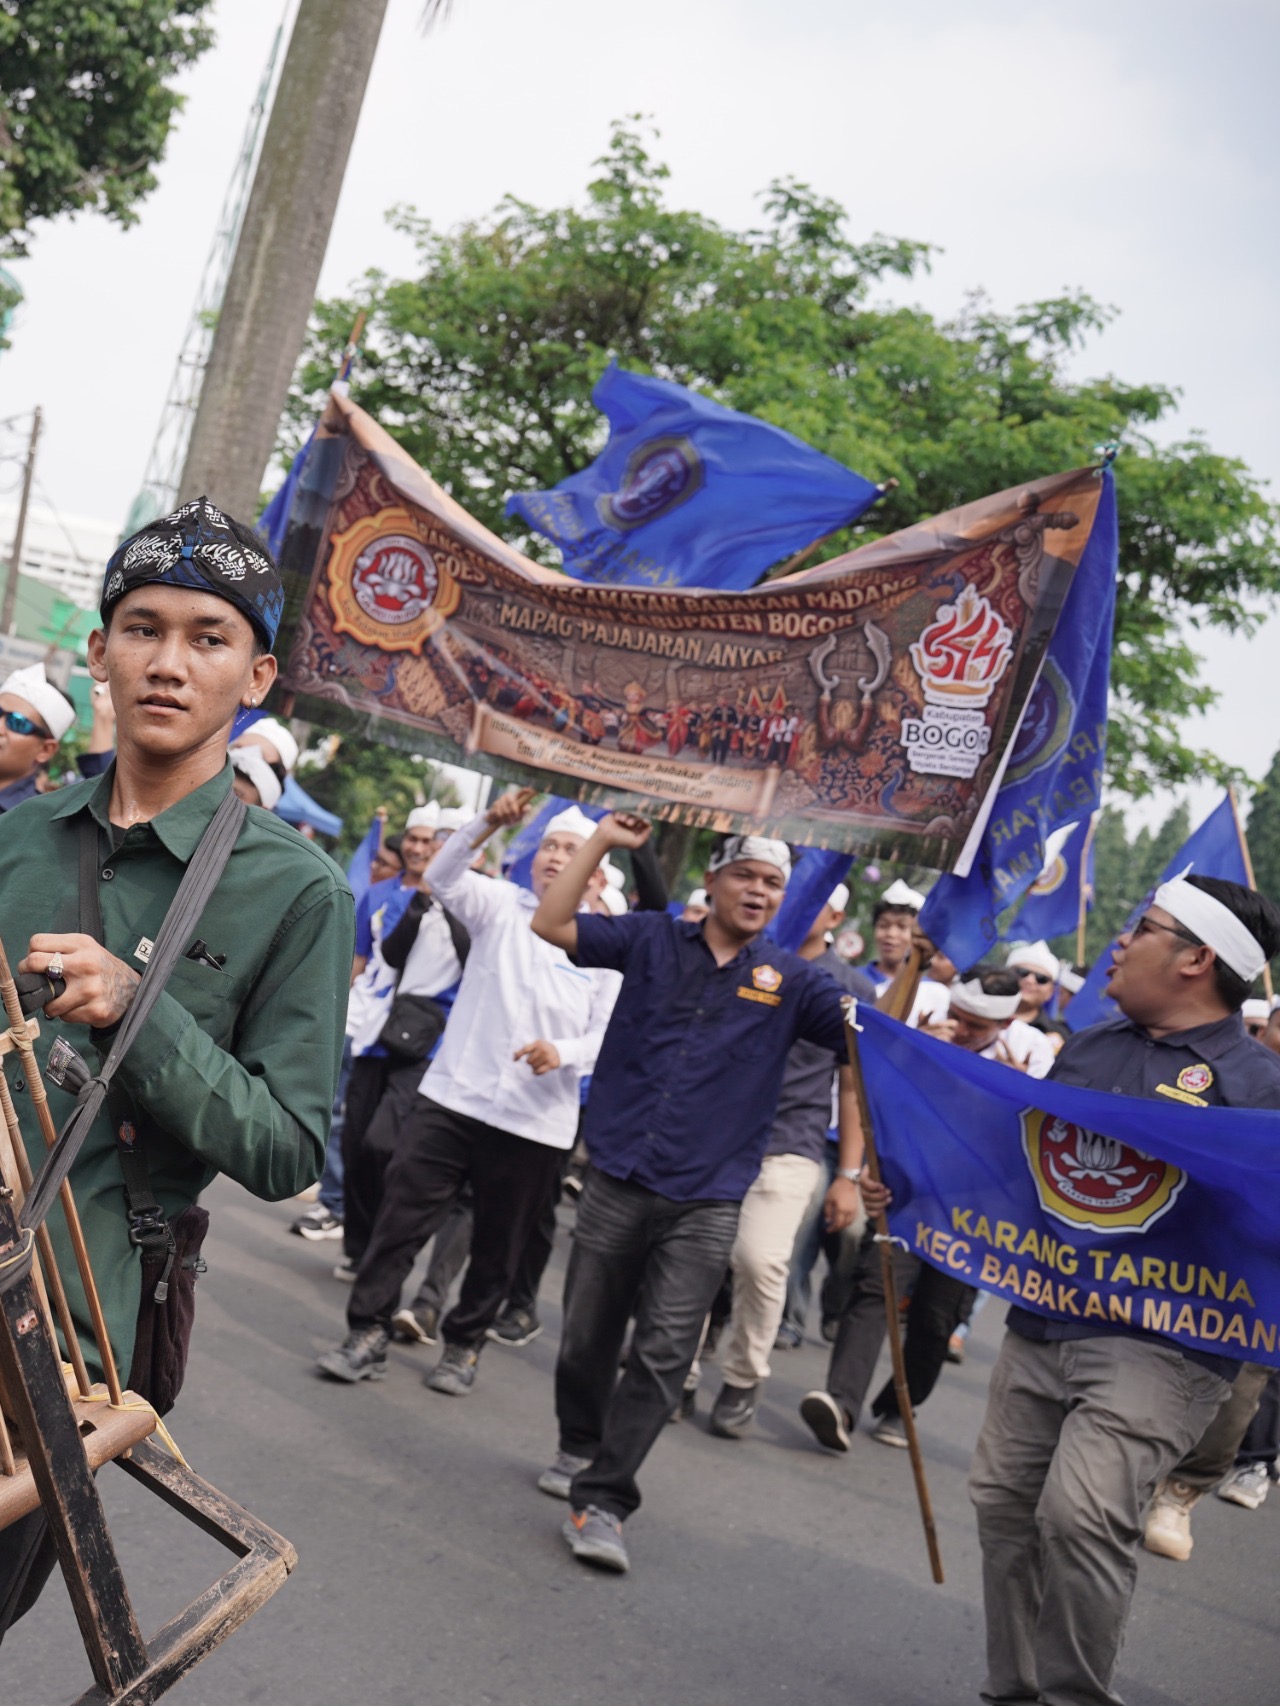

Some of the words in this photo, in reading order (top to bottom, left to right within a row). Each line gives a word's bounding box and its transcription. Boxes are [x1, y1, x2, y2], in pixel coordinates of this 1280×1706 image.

[768, 611, 855, 638] BOGOR
[806, 574, 919, 610] MADANG
[915, 1220, 973, 1275] KEC.
[978, 1253, 1133, 1326] BABAKAN
[1142, 1297, 1280, 1354] MADAN
[951, 1206, 1079, 1276] KARANG
[1088, 1249, 1256, 1309] TARUNA
